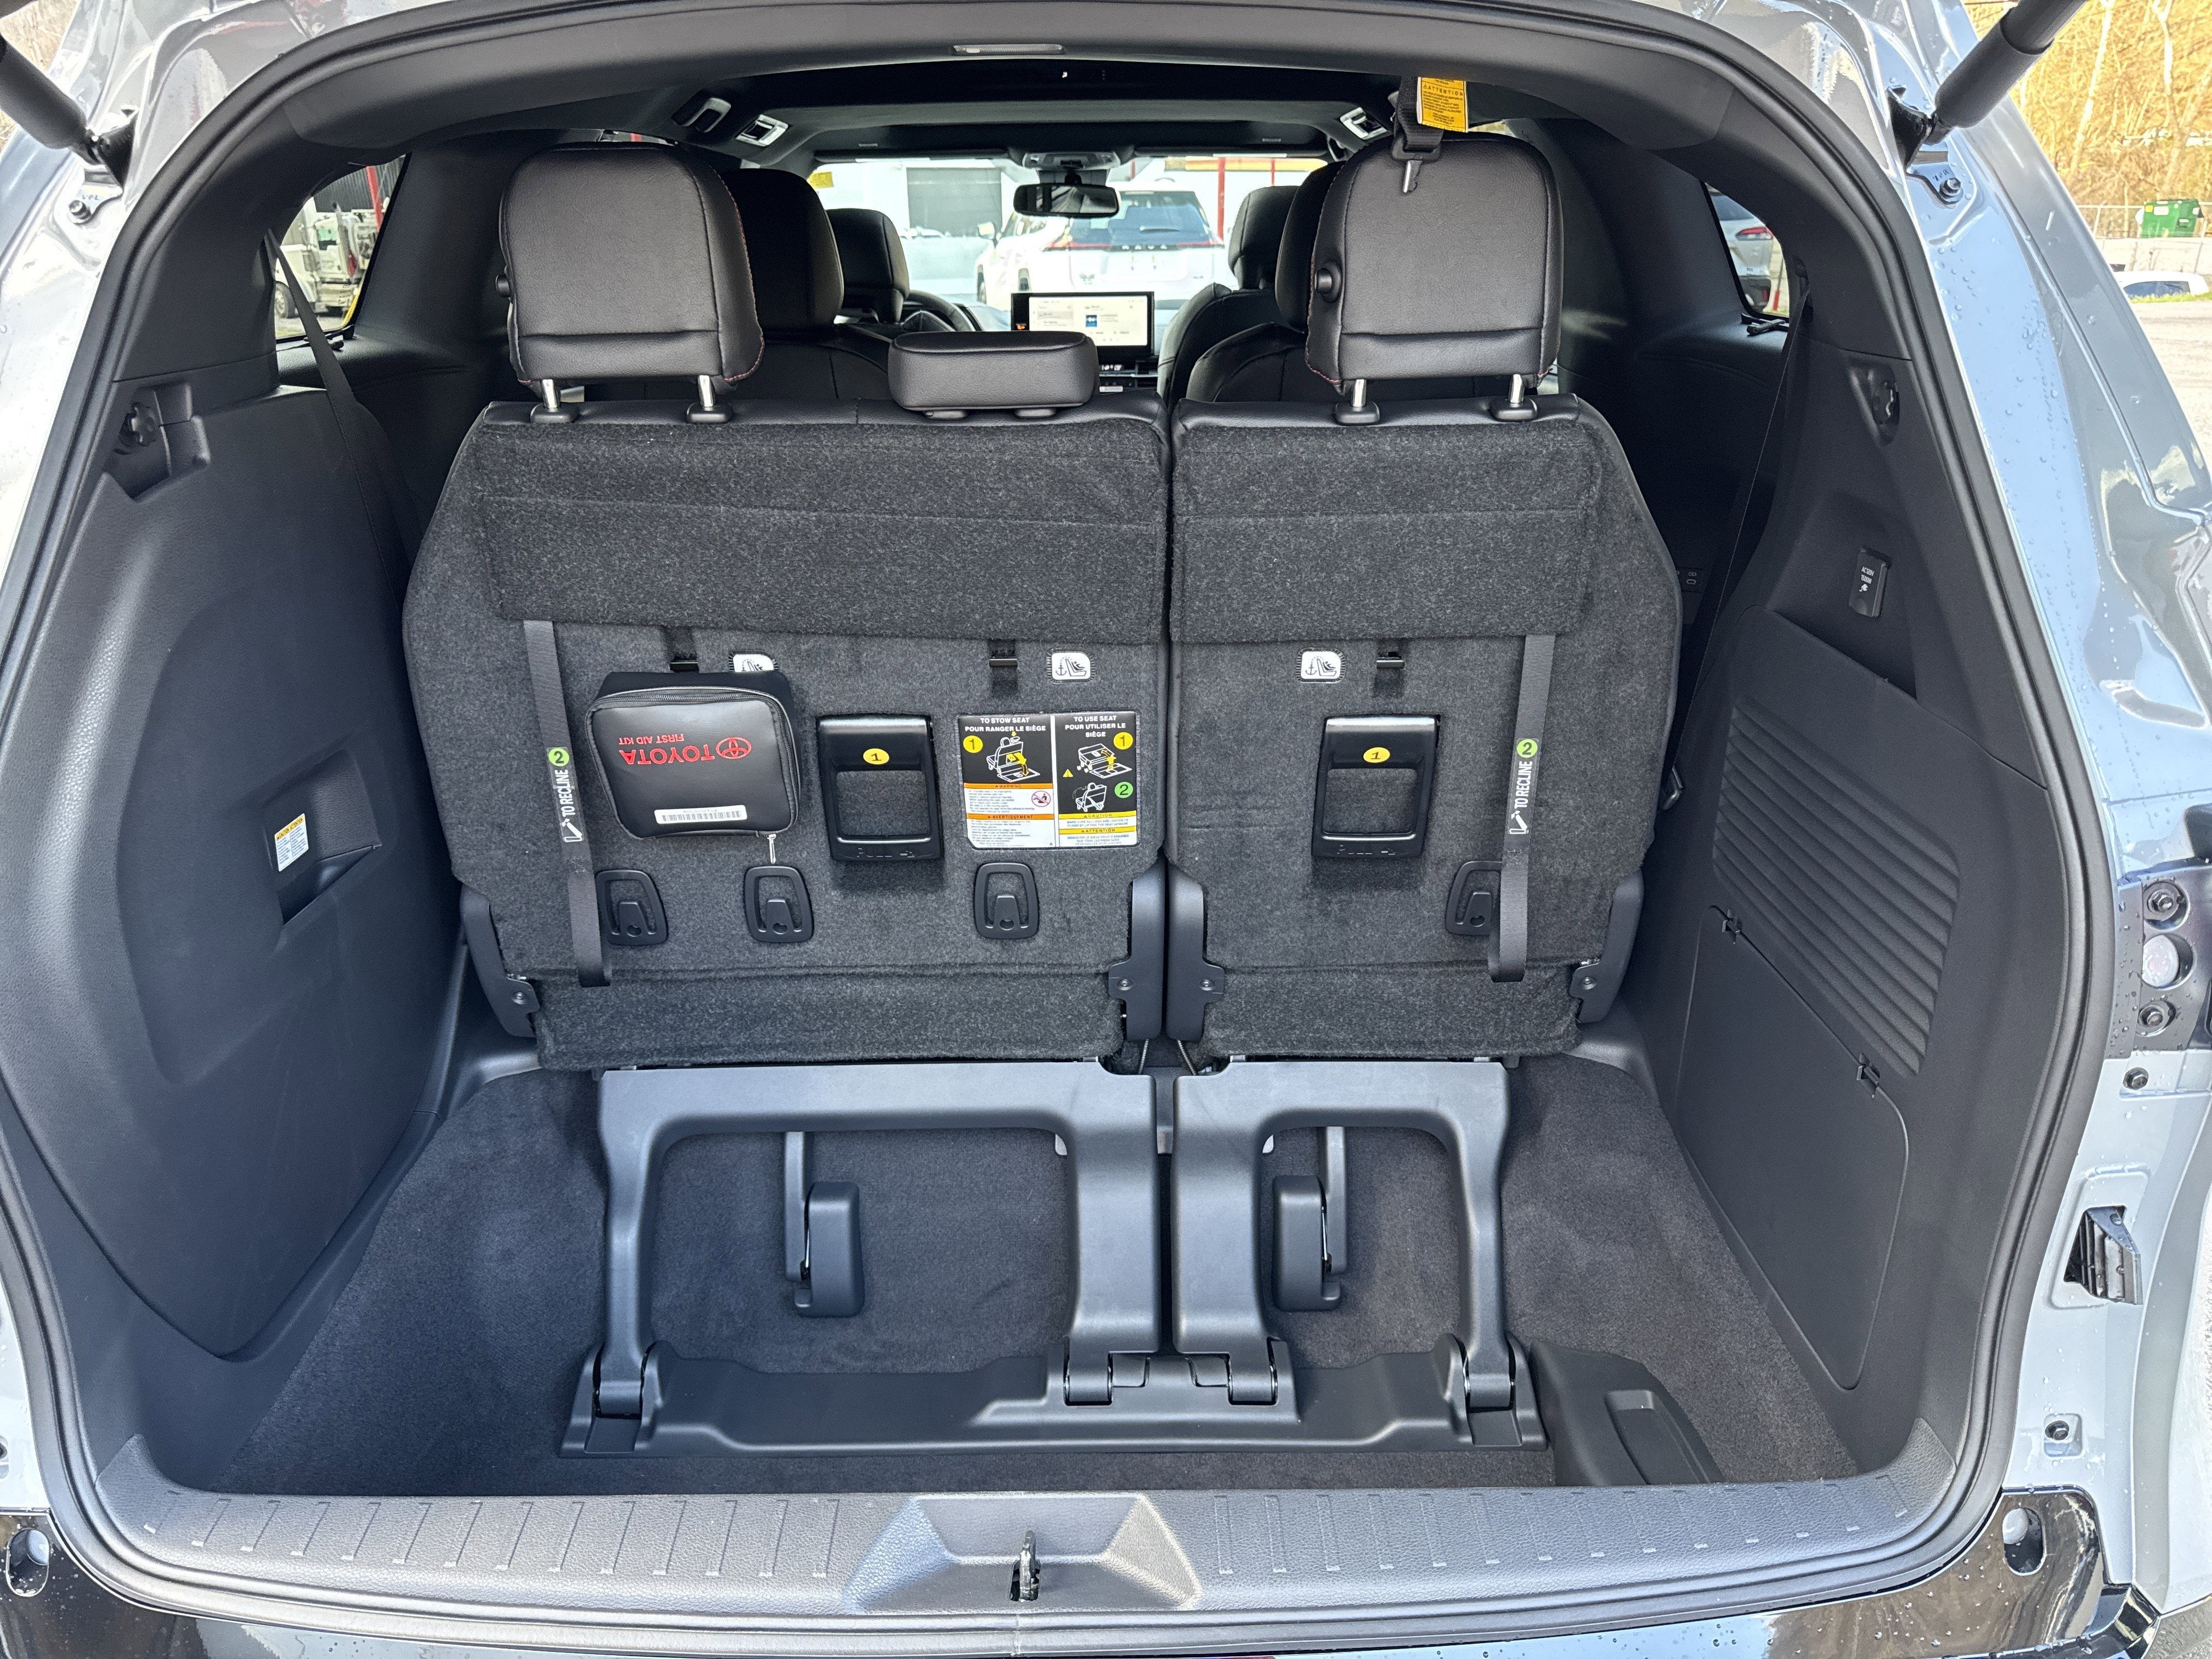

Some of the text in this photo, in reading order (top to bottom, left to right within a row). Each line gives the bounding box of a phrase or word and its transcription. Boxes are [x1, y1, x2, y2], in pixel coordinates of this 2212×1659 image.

[1428, 86, 1463, 96] ATTENTION
[618, 733, 685, 745] FIRST AID KIT
[969, 738, 975, 751] 1
[1120, 735, 1125, 747] 1
[618, 744, 715, 765] TOYOTA
[1522, 742, 1532, 755] 2
[554, 751, 565, 764] 2
[871, 753, 882, 761] 1
[1370, 752, 1381, 760] 1
[1119, 784, 1128, 795] 2
[1514, 760, 1533, 809] TO RECLINE
[555, 769, 576, 817] TO RECLINE
